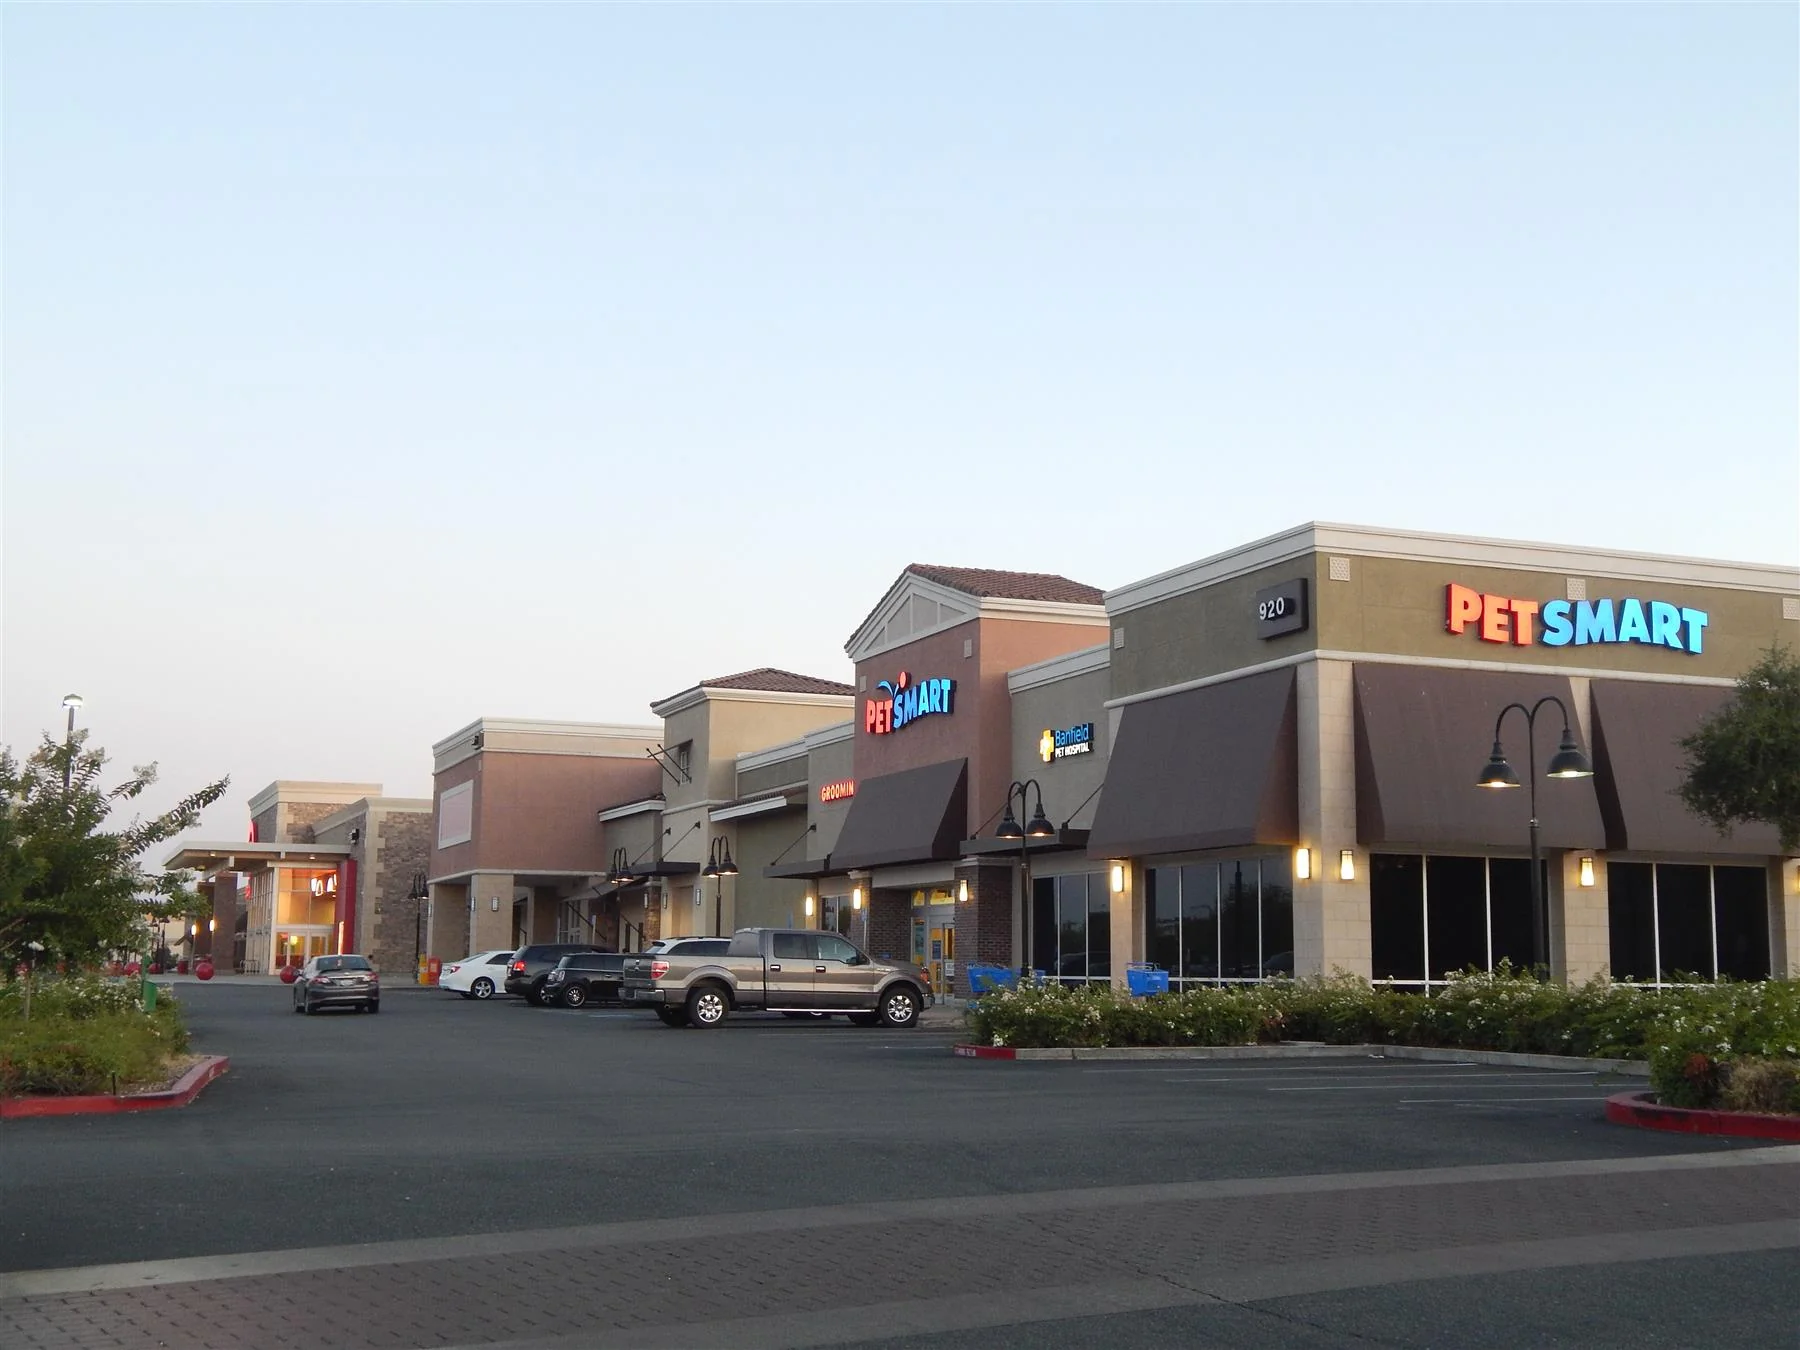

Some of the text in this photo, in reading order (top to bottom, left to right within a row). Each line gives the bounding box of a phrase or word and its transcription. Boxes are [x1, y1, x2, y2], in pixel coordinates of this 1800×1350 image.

[1259, 597, 1285, 620] 920
[1055, 723, 1090, 747] Banfield
[1055, 742, 1090, 758] PET HOSPITAL
[821, 780, 854, 802] GROOMIN
